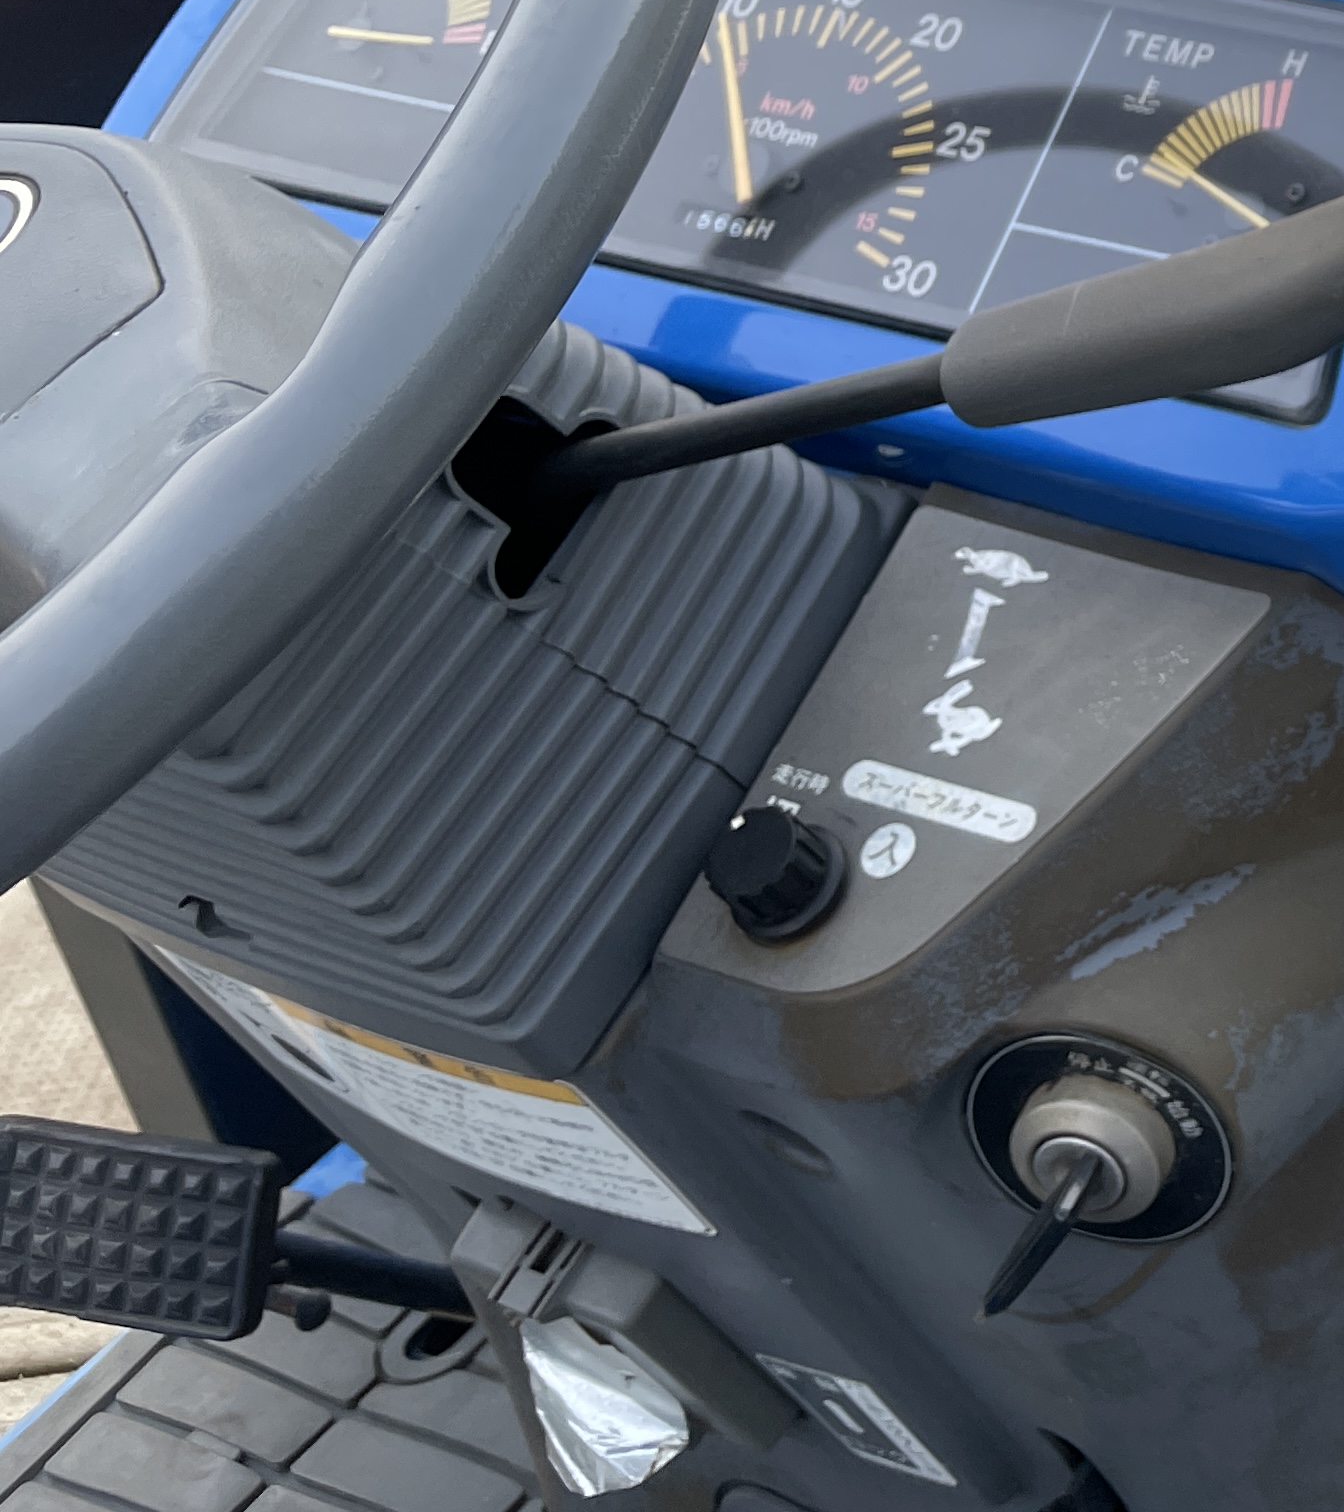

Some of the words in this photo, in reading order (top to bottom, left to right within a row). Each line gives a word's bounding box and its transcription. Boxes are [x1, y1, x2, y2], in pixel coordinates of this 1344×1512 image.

[909, 12, 964, 53] 20
[1123, 29, 1216, 69] TEMP
[1281, 48, 1309, 78] H
[847, 74, 869, 95] 10
[759, 90, 816, 121] km/h
[935, 121, 992, 163] 25
[1114, 153, 1139, 182] C
[856, 211, 878, 233] 15
[882, 254, 938, 298] 30
[868, 831, 899, 867] 入
